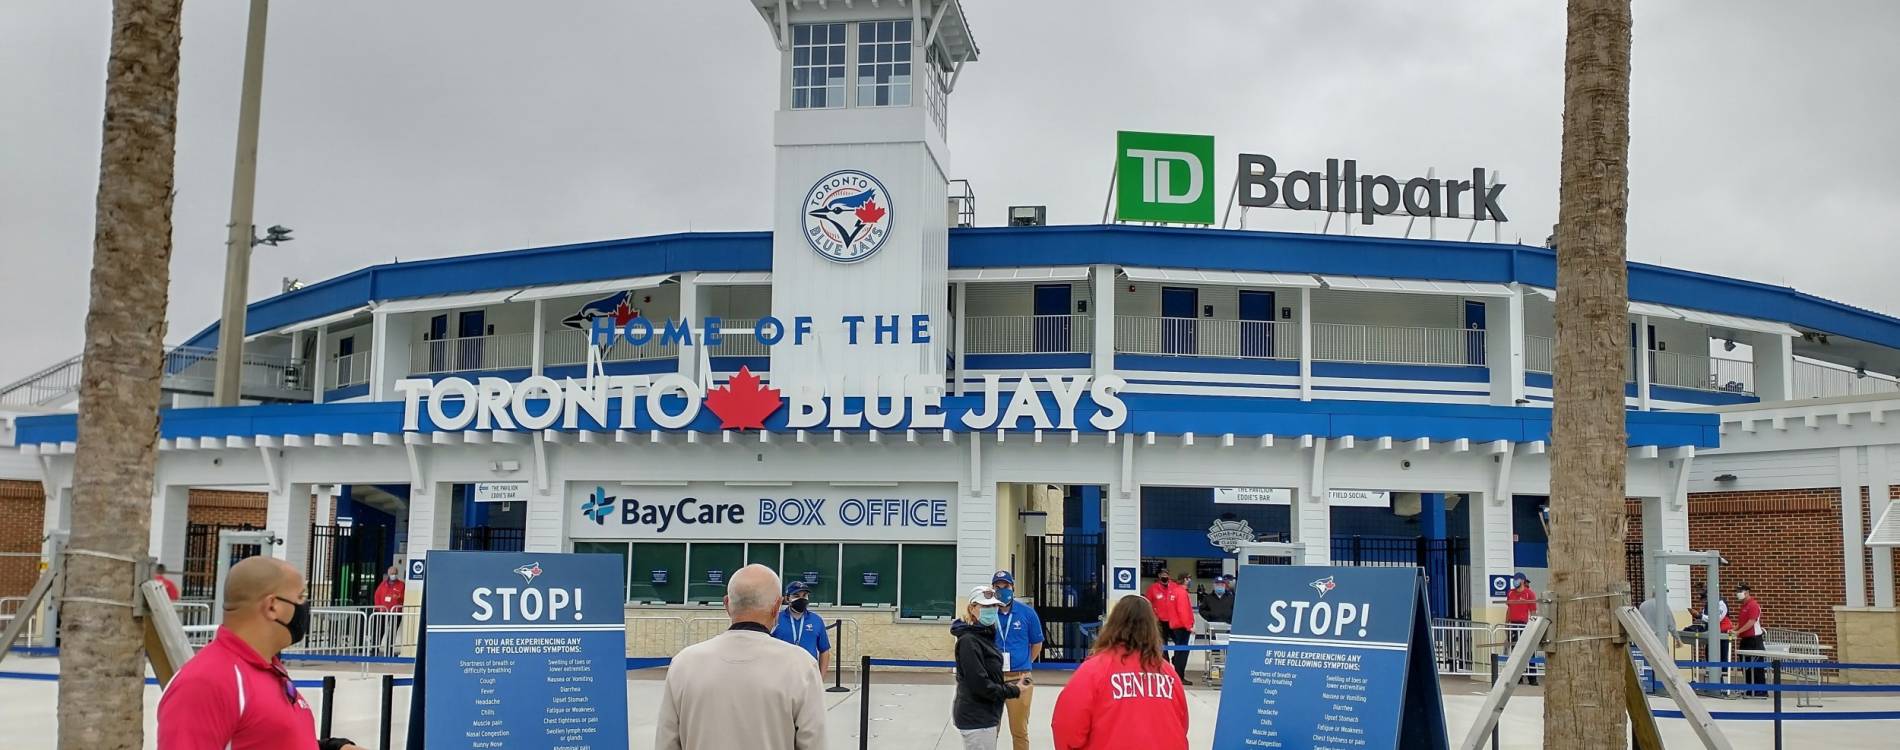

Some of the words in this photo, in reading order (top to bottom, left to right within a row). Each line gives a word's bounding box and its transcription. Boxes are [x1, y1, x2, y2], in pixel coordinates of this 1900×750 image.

[811, 176, 868, 206] TORONTO
[1127, 148, 1204, 204] TD
[1238, 153, 1508, 225] Ballpark
[809, 225, 843, 256] BLUE
[850, 226, 883, 256] JAYS
[591, 316, 723, 346] HOME
[754, 316, 814, 346] OF
[842, 314, 931, 345] THE
[394, 376, 702, 431] TORONTO
[785, 373, 948, 429] BLUE
[961, 371, 1128, 431] JAYS
[1333, 491, 1347, 499] FIELD
[1349, 491, 1367, 499] SOCIAL
[621, 498, 745, 532] BayCare
[759, 498, 826, 526] BOX
[839, 498, 948, 527] OFFICE
[471, 587, 583, 621] STOP!
[1267, 600, 1370, 638] STOP!
[475, 638, 482, 646] IF
[484, 638, 499, 646] YOU
[500, 638, 514, 646] ARE
[515, 637, 566, 646] EXPERIENCING
[567, 637, 581, 645] ANY
[475, 646, 484, 654] OF
[486, 646, 500, 654] THE
[502, 646, 541, 654] FOLLOWING
[543, 645, 582, 653] SYMPTOMS:
[1266, 649, 1273, 657] IF
[1274, 650, 1286, 658] YOU
[1287, 651, 1300, 659] ARE
[1300, 652, 1346, 661] EXPERIENCING
[1347, 655, 1361, 663] ANY
[464, 667, 487, 675] difficulty
[1264, 657, 1273, 665] OF
[1274, 658, 1286, 666] THE
[1287, 659, 1322, 669] FOLLOWING
[1323, 662, 1360, 671] SYMPTOMS:
[1111, 672, 1175, 700] SENTRY
[481, 730, 510, 738] Congestion
